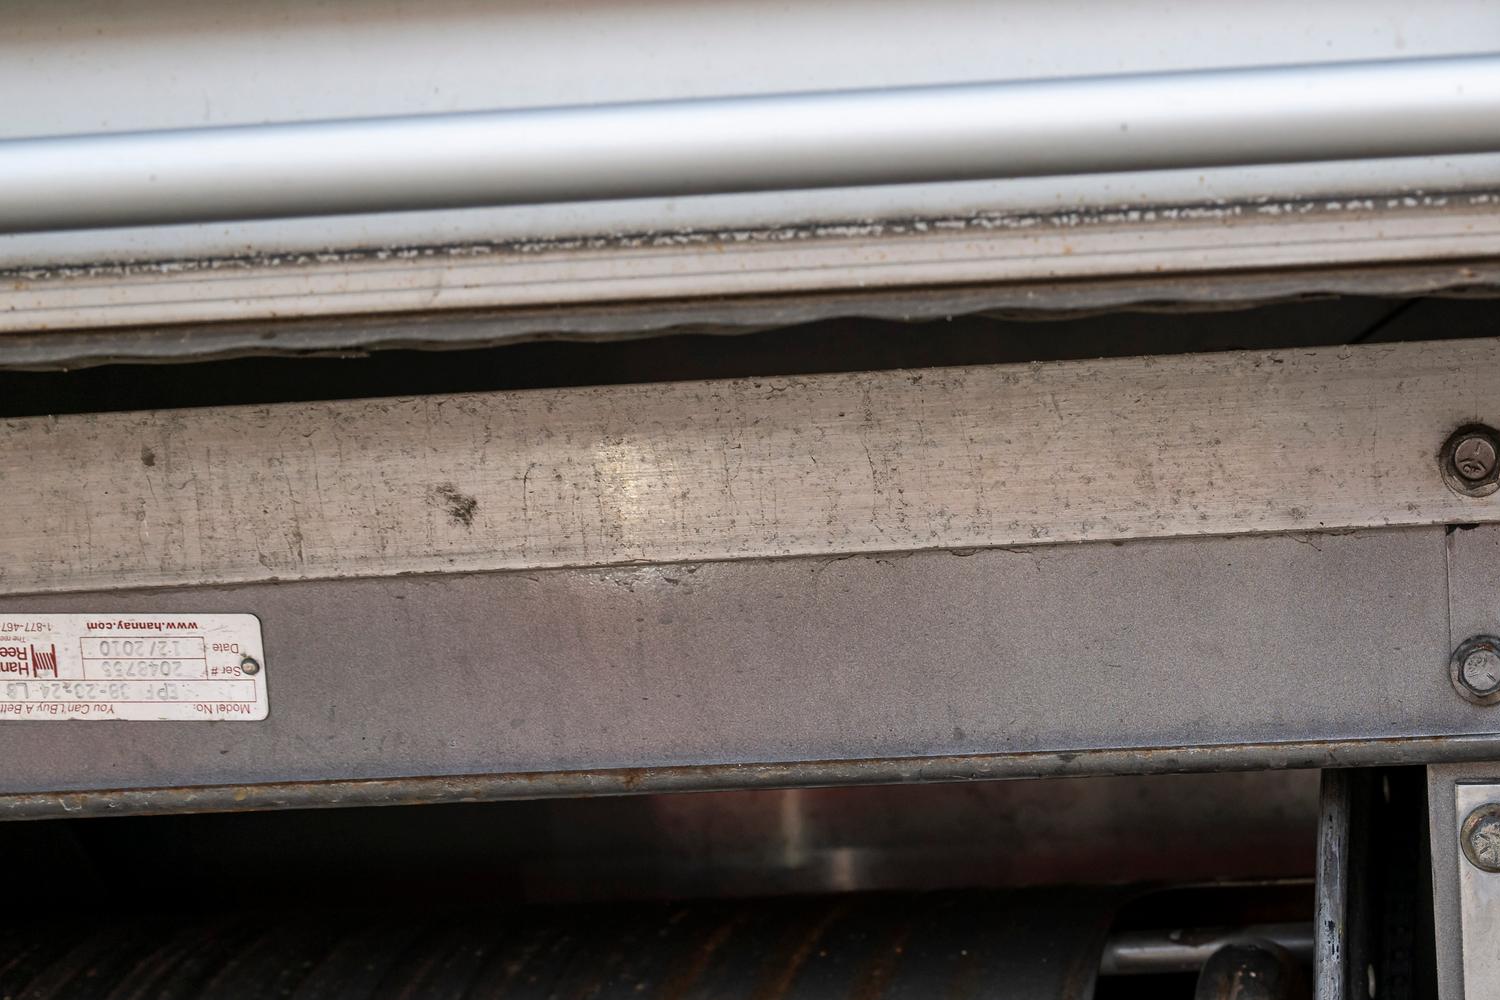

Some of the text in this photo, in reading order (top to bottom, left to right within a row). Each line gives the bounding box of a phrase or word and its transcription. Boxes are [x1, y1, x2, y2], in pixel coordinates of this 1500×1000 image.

[86, 620, 198, 631] www.hannay.com
[212, 643, 239, 653] Date
[211, 665, 241, 677] Ser #
[26, 703, 34, 714] A
[36, 701, 57, 714] Buy
[61, 703, 90, 714] Can't
[93, 703, 114, 714] You
[216, 703, 250, 714] Model
